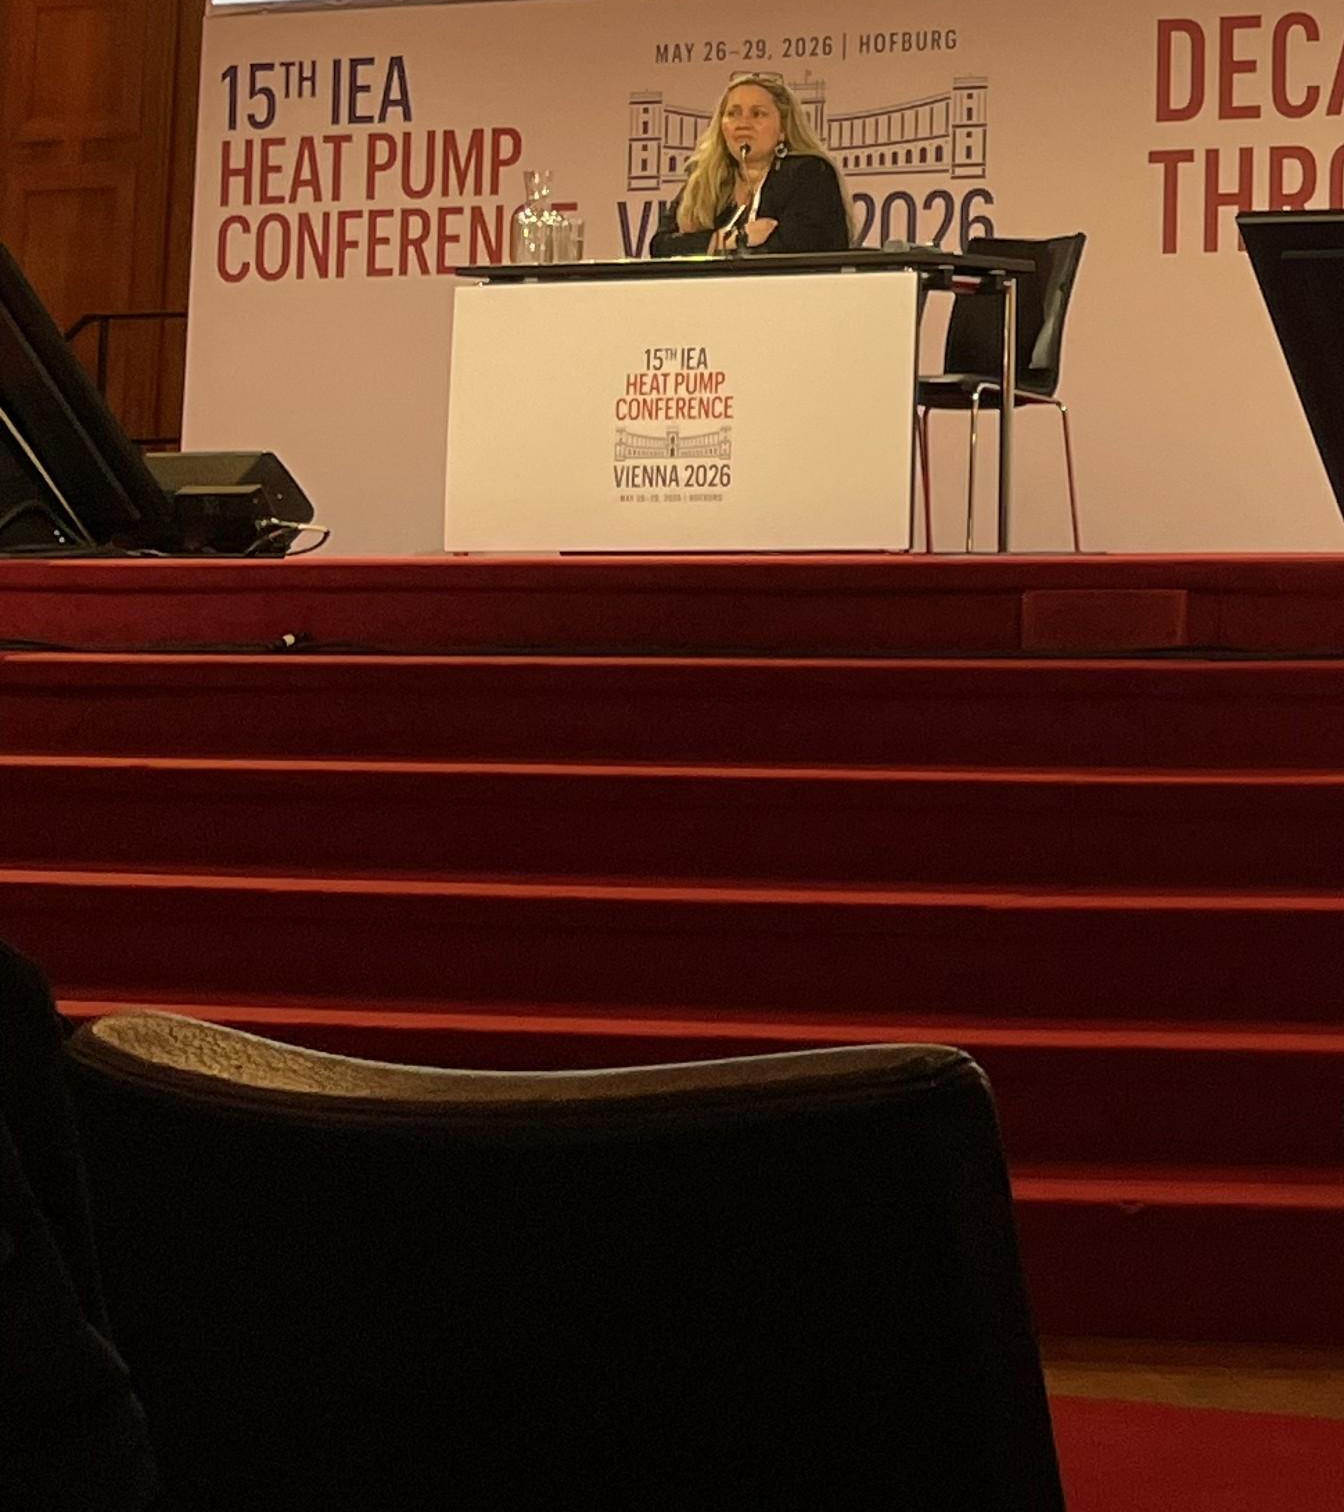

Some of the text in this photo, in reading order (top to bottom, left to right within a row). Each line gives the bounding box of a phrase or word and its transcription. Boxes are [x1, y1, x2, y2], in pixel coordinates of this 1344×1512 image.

[655, 42, 695, 64] MAY
[781, 35, 833, 58] 2026
[858, 29, 958, 54] HOFBURG
[221, 55, 412, 131] 15TH IEA
[220, 127, 523, 207] HEAT PUMP
[644, 347, 708, 371] 15TH IEA
[625, 371, 725, 396] HEAT PUMP
[615, 396, 734, 421] CONFERENCE
[614, 463, 731, 488] VIENNA 2026
